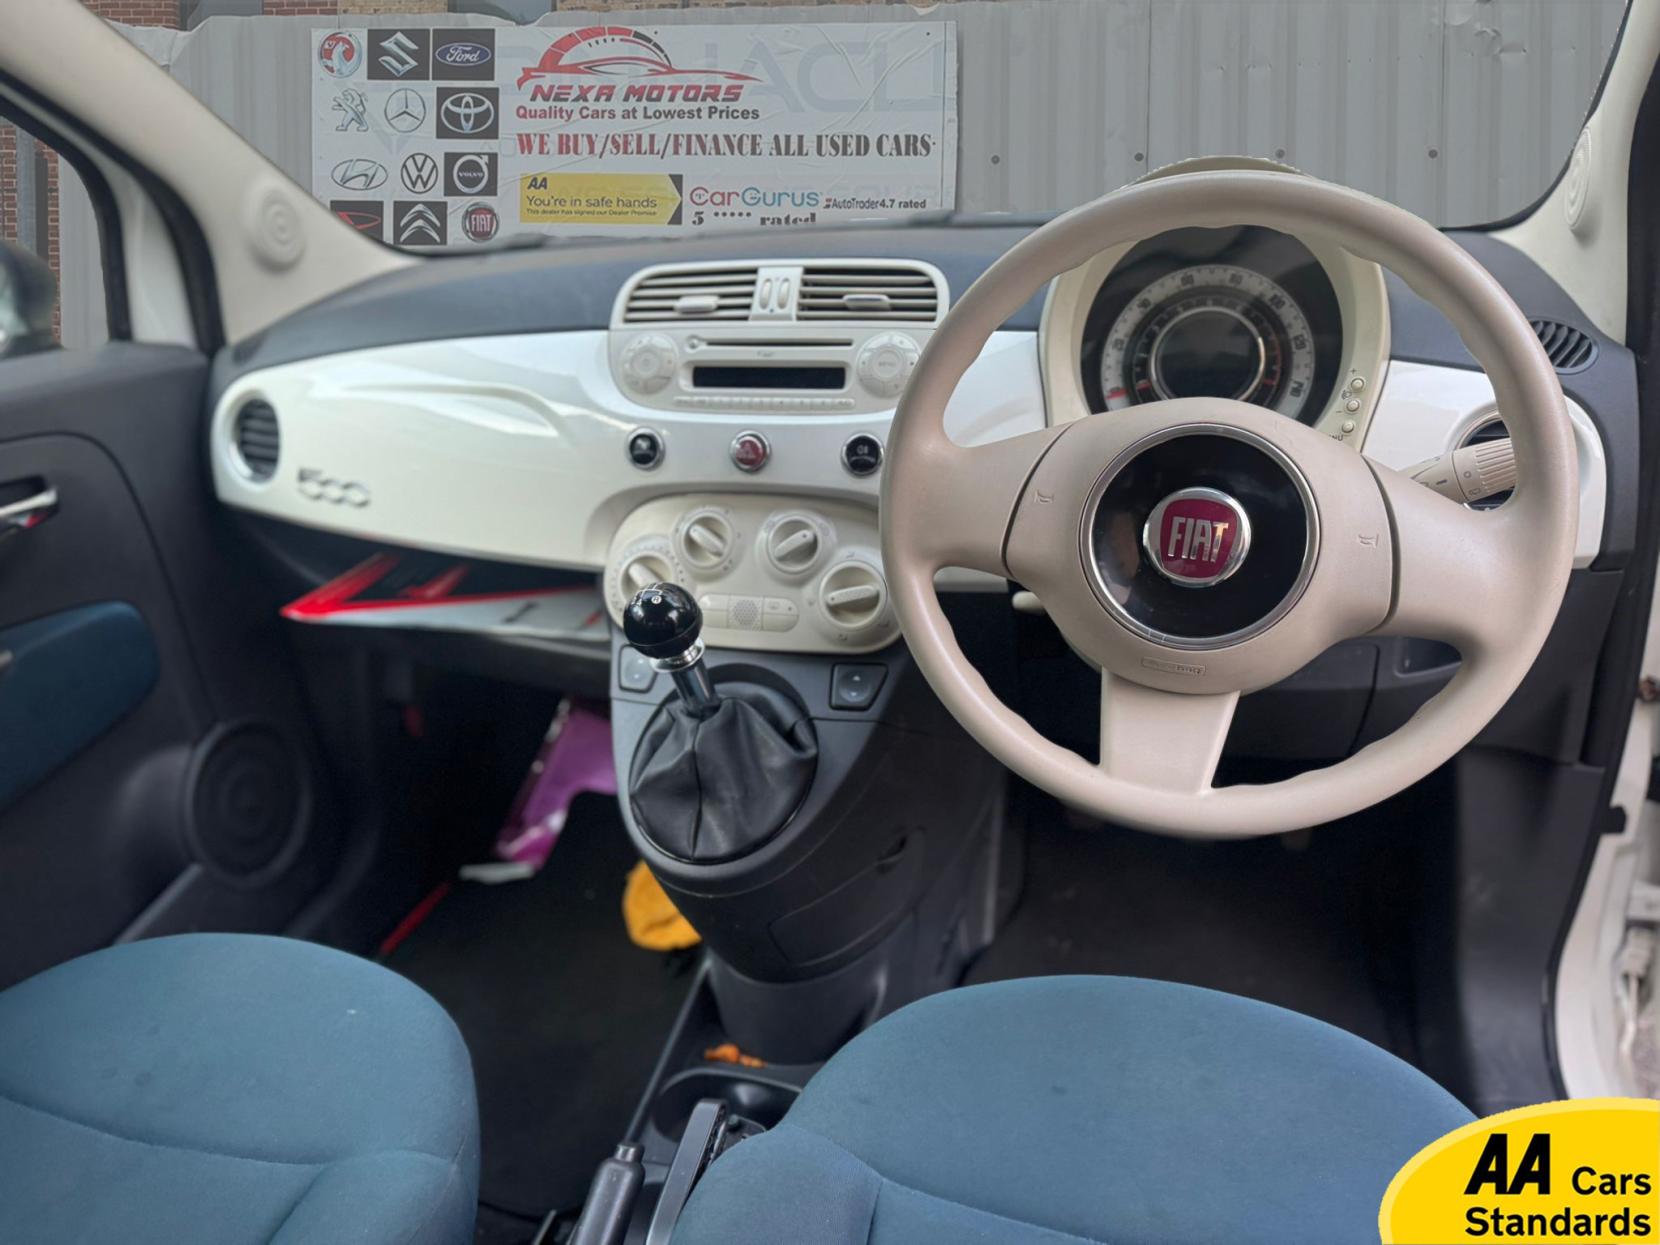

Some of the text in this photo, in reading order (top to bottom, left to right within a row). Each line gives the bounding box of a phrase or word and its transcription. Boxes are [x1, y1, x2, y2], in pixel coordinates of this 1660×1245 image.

[446, 46, 480, 63] Ford
[530, 84, 744, 102] NEXA MOTORS
[516, 105, 760, 122] Quality Cars at Lowest Prices
[516, 133, 550, 155] WE
[769, 133, 809, 157] ALL
[816, 133, 870, 157] USED
[527, 176, 548, 190] AA
[526, 195, 657, 208] You're in safe hands
[690, 186, 820, 207] CarGurus
[898, 198, 927, 209] rated
[471, 214, 492, 232] FIAT
[692, 211, 705, 226] 5
[298, 467, 371, 509] 500
[1167, 515, 1230, 564] FIAT
